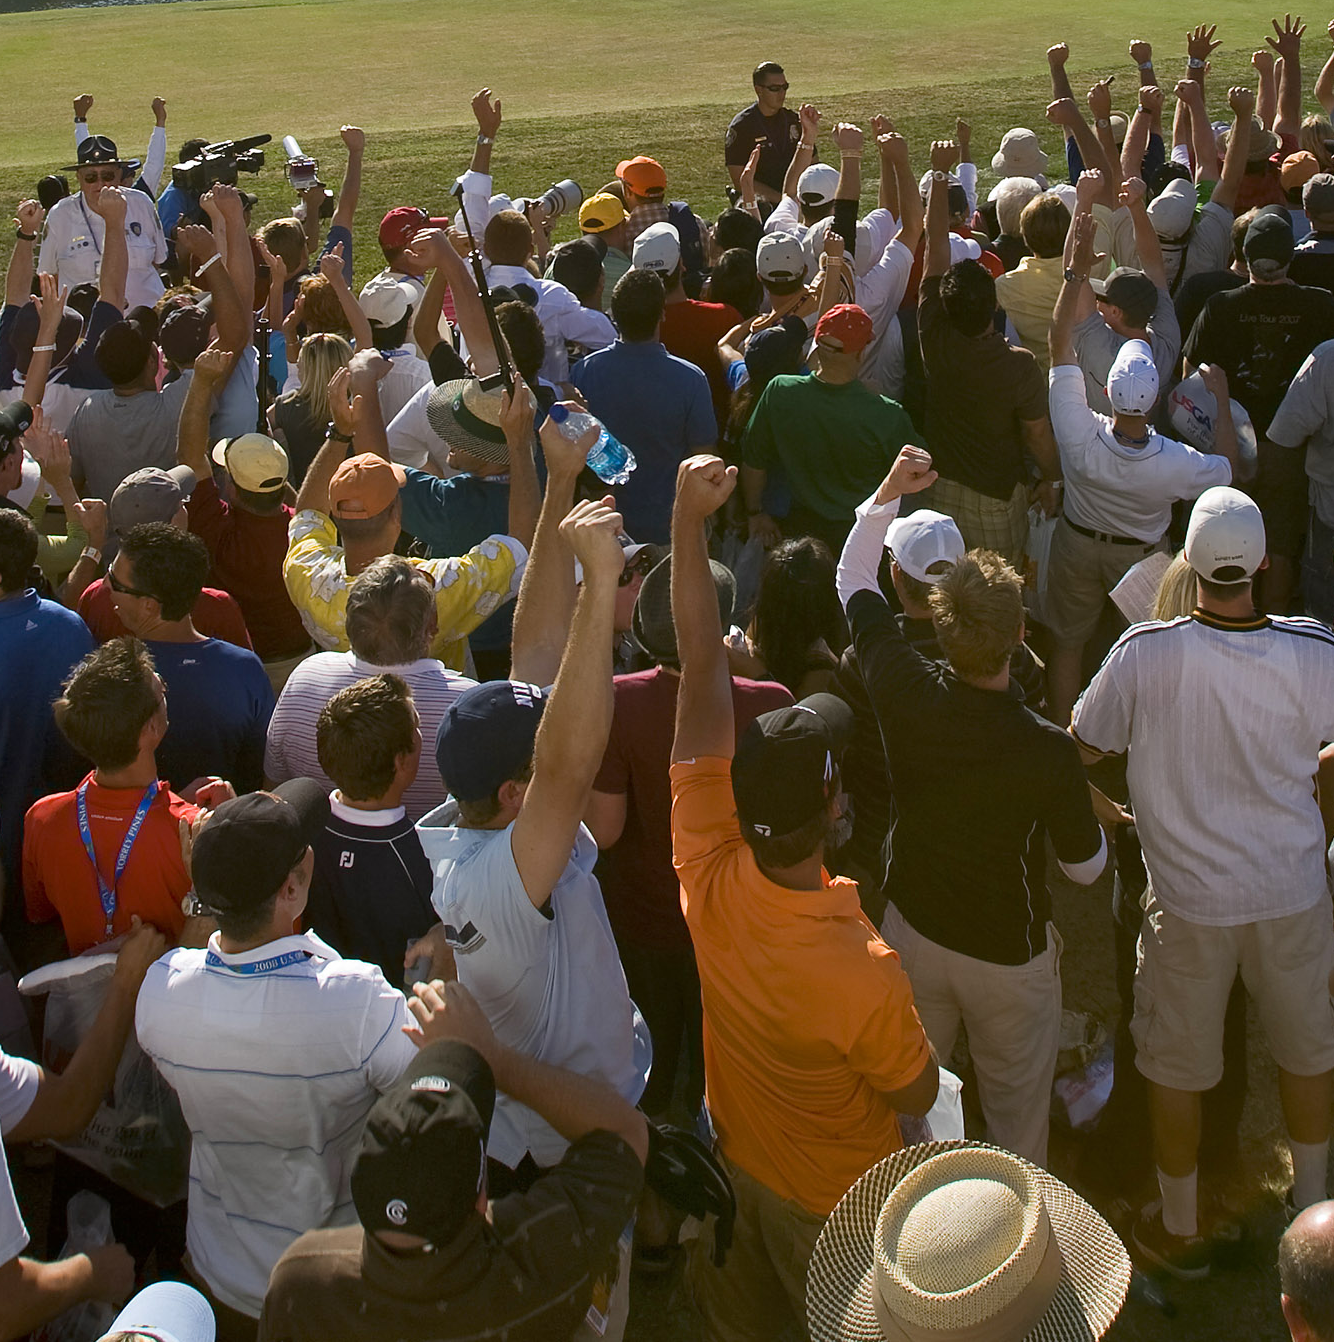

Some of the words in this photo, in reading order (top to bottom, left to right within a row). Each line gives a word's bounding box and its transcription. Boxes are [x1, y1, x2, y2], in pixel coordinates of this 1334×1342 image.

[1259, 313, 1276, 323] Tour
[1278, 314, 1301, 324] 2007
[1171, 390, 1212, 432] USGA
[116, 836, 137, 872] TORREY
[127, 808, 147, 839] PINES
[339, 851, 355, 868] FJ
[254, 959, 278, 973] 2008
